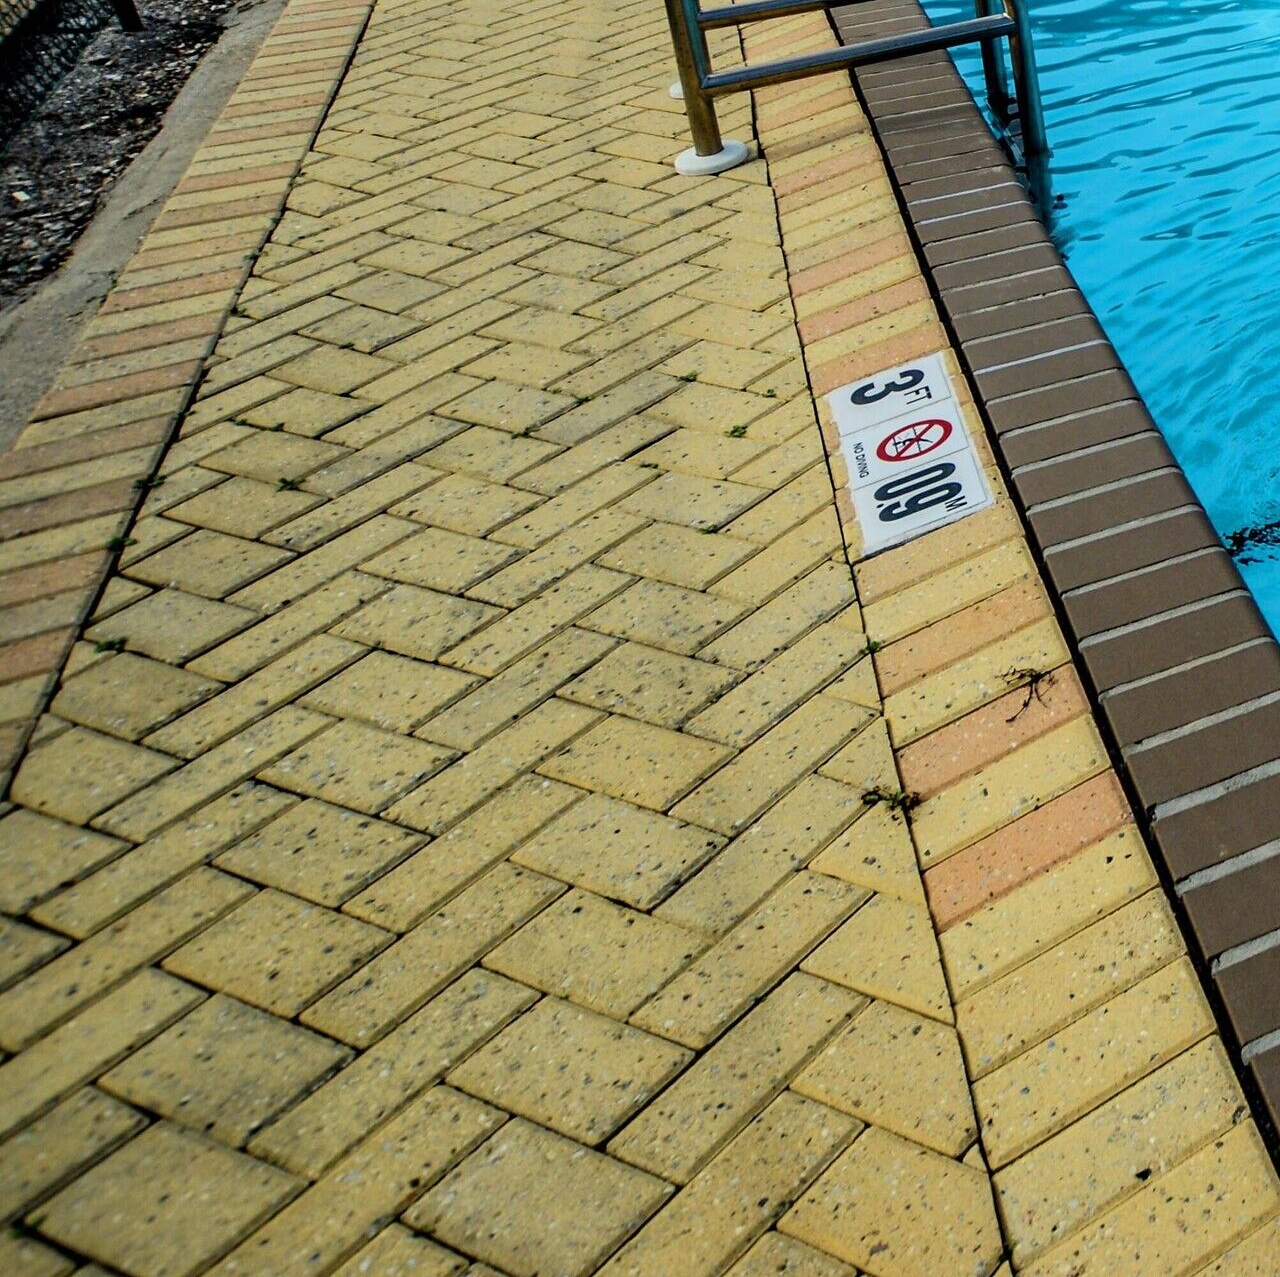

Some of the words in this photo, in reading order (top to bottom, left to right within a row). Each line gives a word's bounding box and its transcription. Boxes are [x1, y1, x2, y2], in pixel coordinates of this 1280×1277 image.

[850, 369, 925, 406] 3
[903, 385, 932, 405] FT
[853, 442, 864, 454] NO
[855, 453, 870, 479] DIVING
[873, 462, 962, 522] 0.9
[944, 495, 968, 512] M
